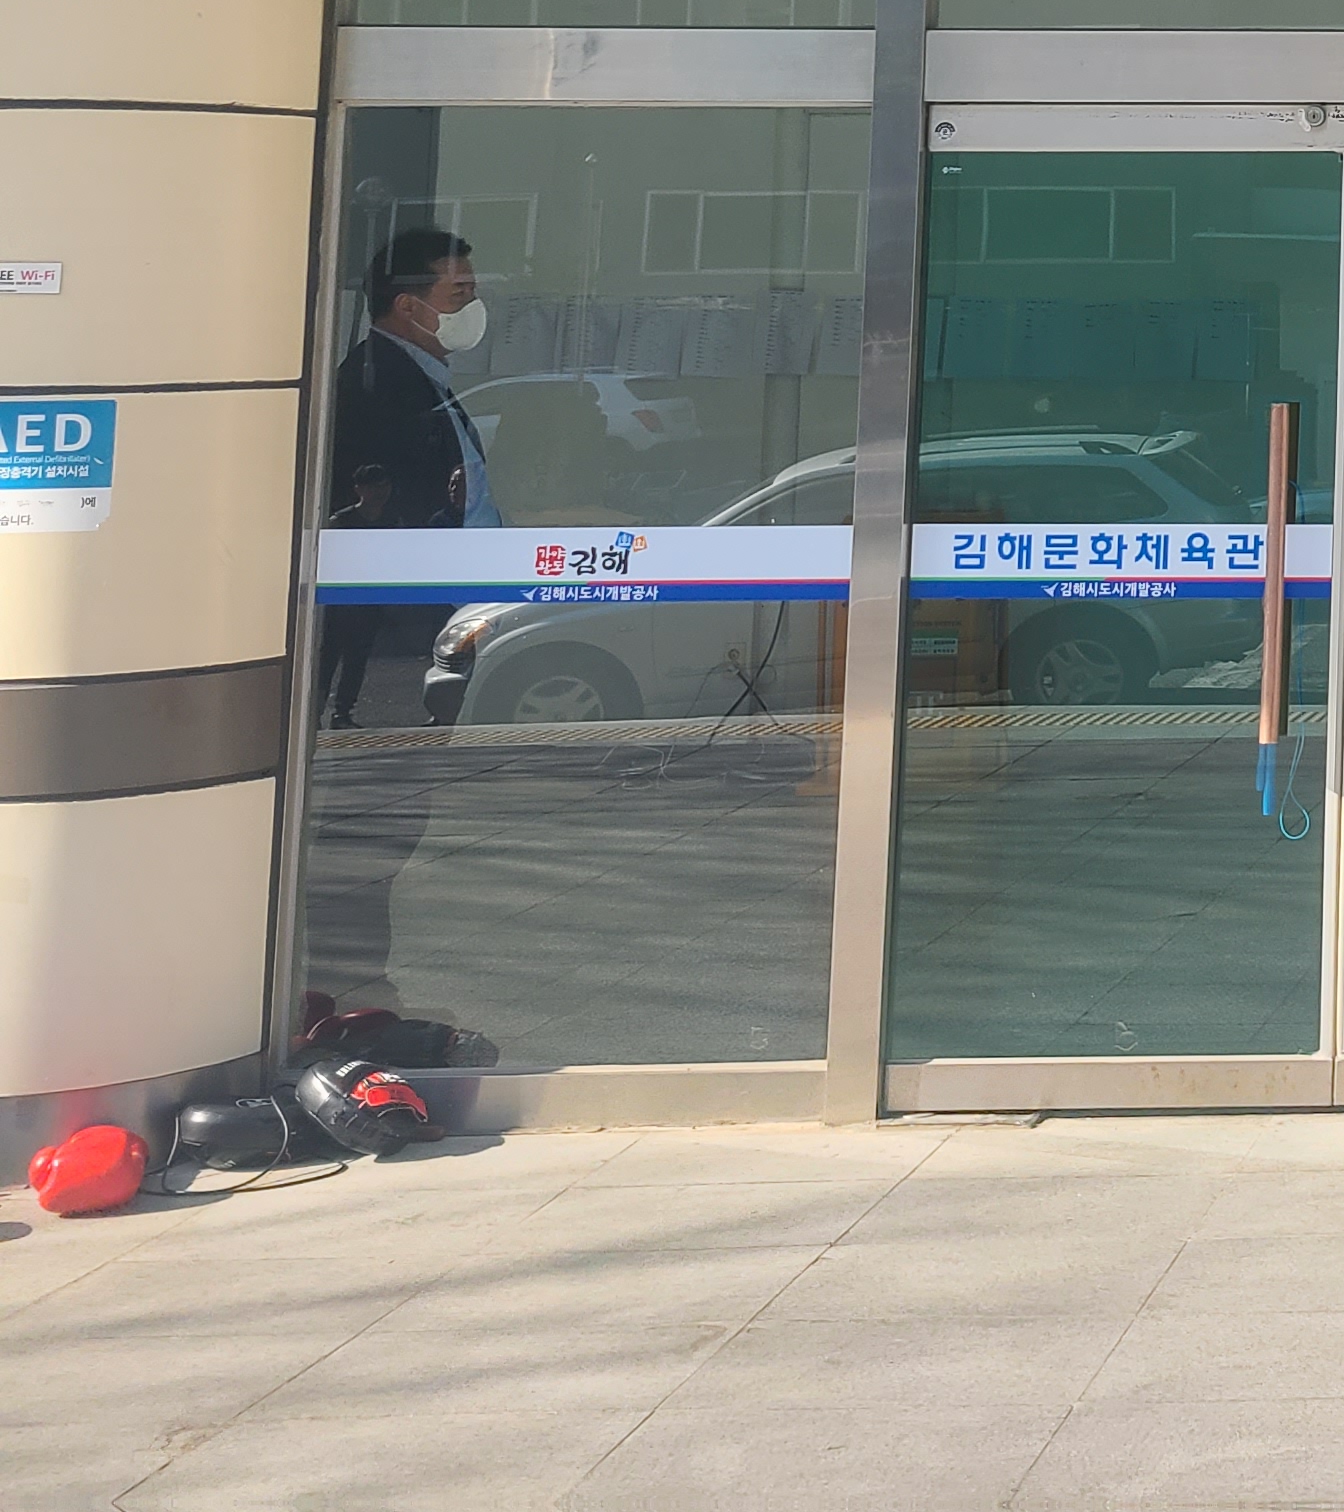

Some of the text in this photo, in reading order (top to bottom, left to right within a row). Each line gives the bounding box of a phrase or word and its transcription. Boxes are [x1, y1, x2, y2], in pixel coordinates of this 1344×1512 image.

[20, 270, 56, 281] Wi-Fi
[0, 413, 92, 453] ED
[45, 464, 90, 478] 설치시설
[953, 532, 1264, 570] 김해문화체육관
[568, 545, 630, 576] 김해
[539, 585, 659, 601] 김해시도시개발공사
[1060, 581, 1177, 598] 김해시도시개발공사
